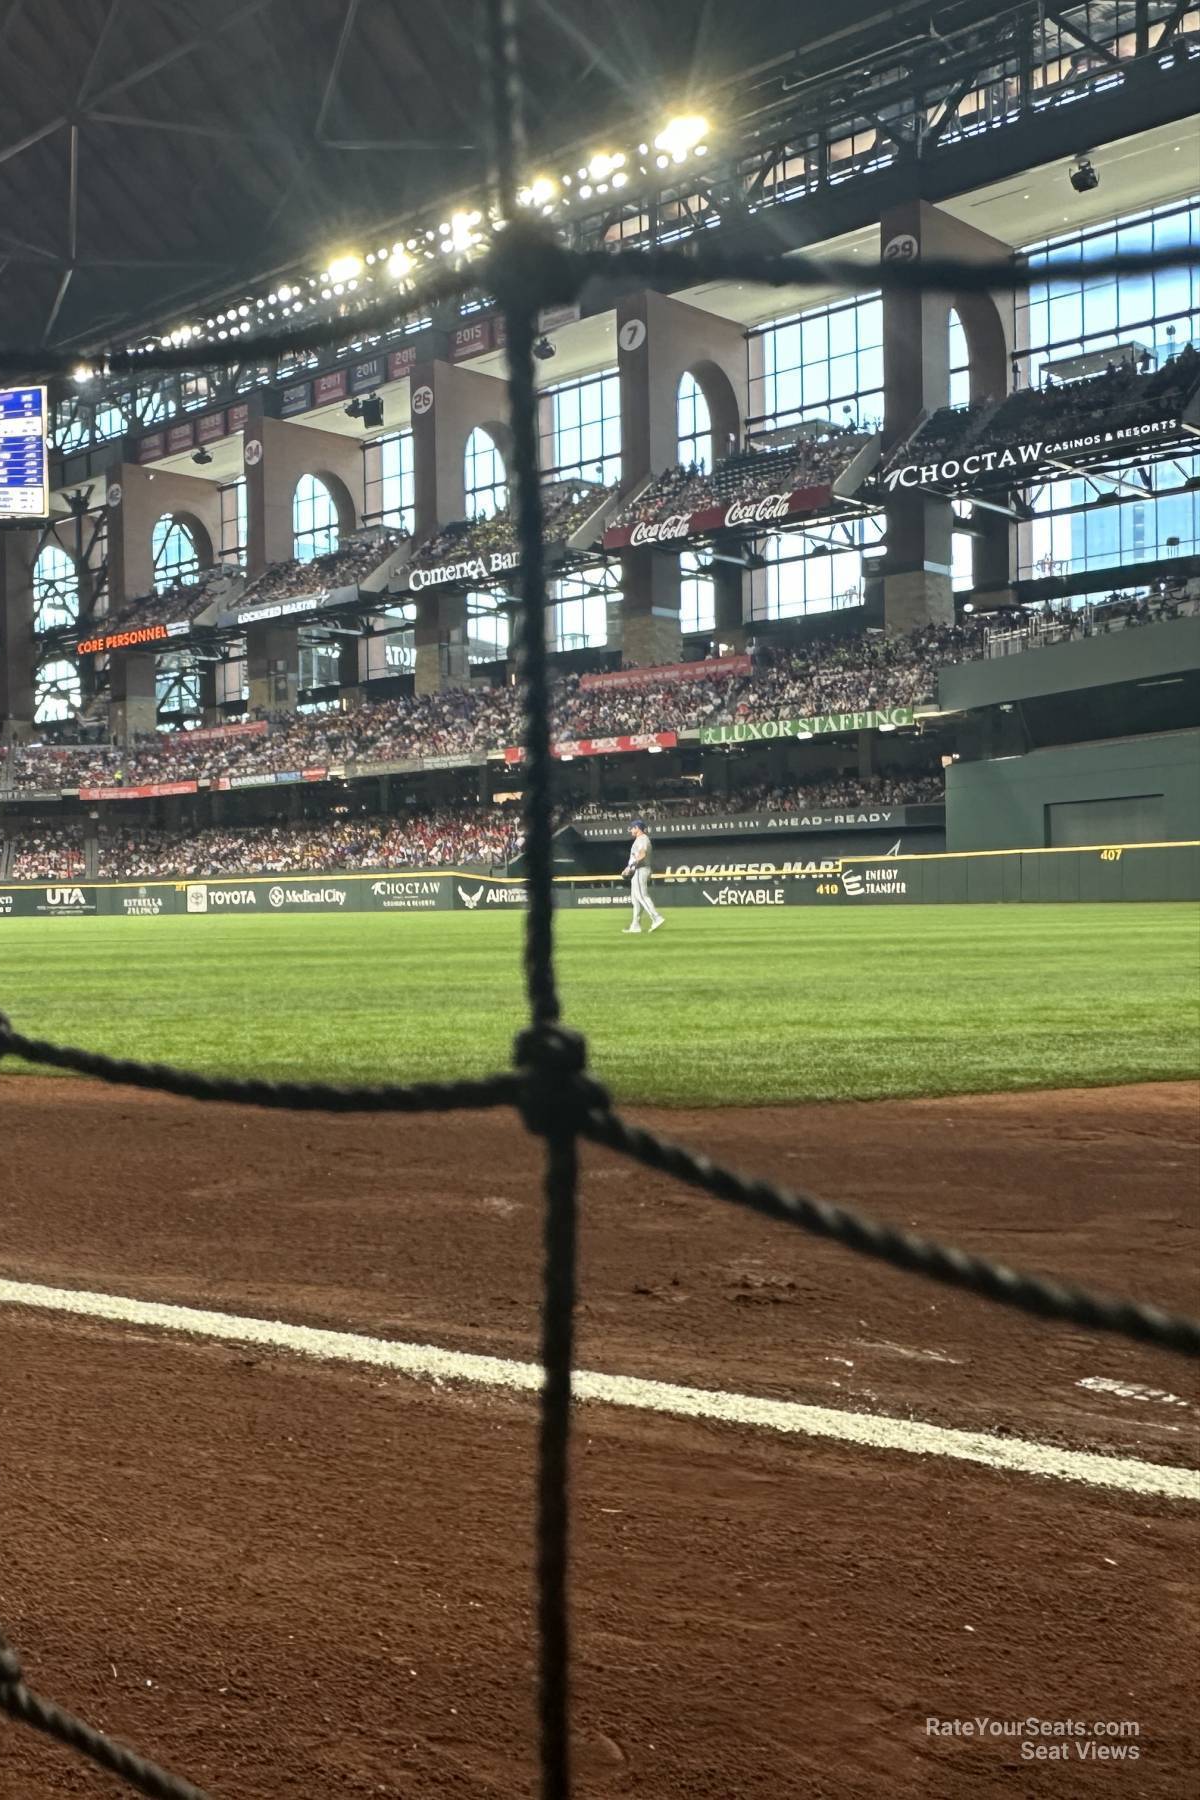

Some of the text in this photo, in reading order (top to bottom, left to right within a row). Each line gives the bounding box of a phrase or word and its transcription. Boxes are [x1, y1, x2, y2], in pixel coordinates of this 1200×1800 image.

[456, 324, 482, 345] 2015
[627, 327, 640, 346] 7
[356, 361, 377, 378] 2011
[413, 391, 432, 409] 26
[899, 418, 1177, 487] CHOCTAW CASINOS & RESORTS
[490, 551, 521, 573] Ban
[77, 625, 167, 654] CORE PERSONNEL
[719, 707, 907, 743] LUXOR STAFFING
[1100, 849, 1122, 861] 407
[865, 869, 898, 881] ENERGY
[46, 888, 86, 905] UTA
[375, 881, 441, 895] CHOCTAW
[486, 889, 507, 903] AIR
[816, 884, 838, 895] 410
[865, 882, 906, 894] TRANSFER
[209, 890, 256, 905] TOYOTA
